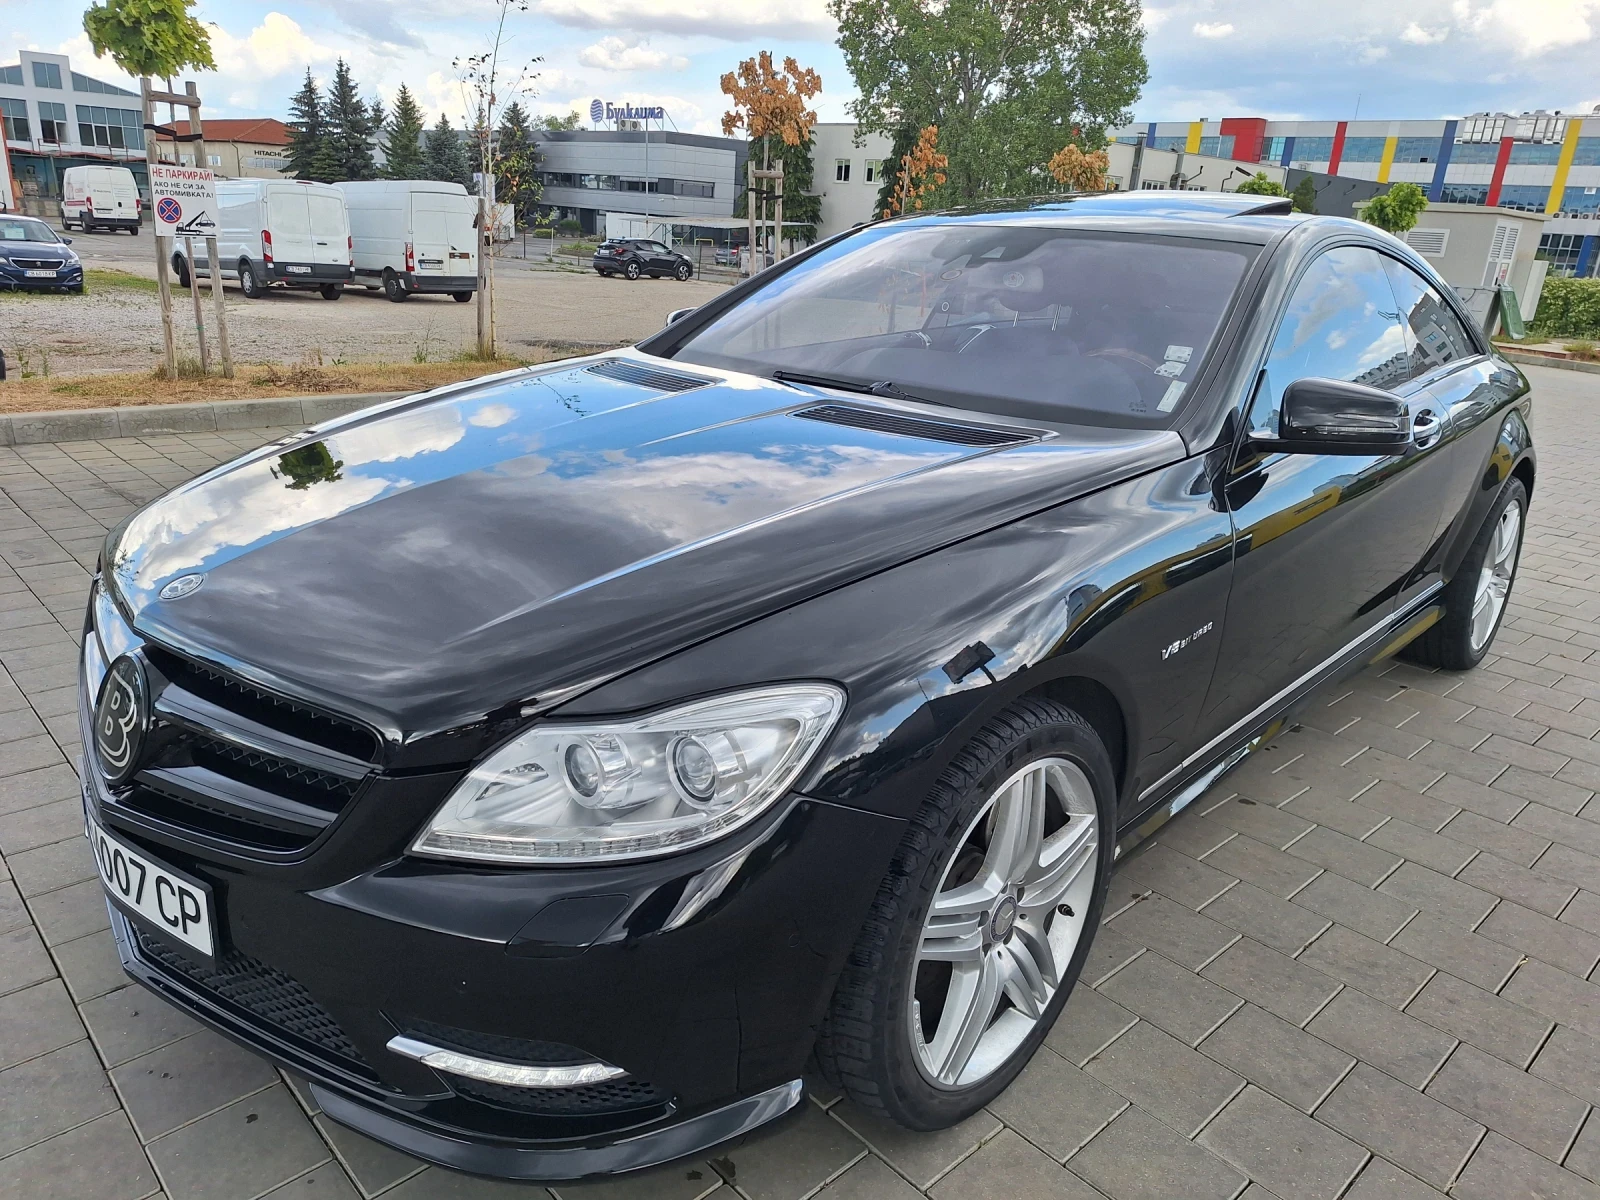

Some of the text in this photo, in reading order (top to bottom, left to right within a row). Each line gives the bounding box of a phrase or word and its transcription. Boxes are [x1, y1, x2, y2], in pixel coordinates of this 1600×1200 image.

[606, 102, 664, 124] Булклима
[152, 167, 213, 181] НЕ ПАРКИРАЙ!
[154, 189, 214, 198] АВТОМИВКАТА!
[1161, 640, 1181, 661] V8
[155, 875, 201, 935] CP
